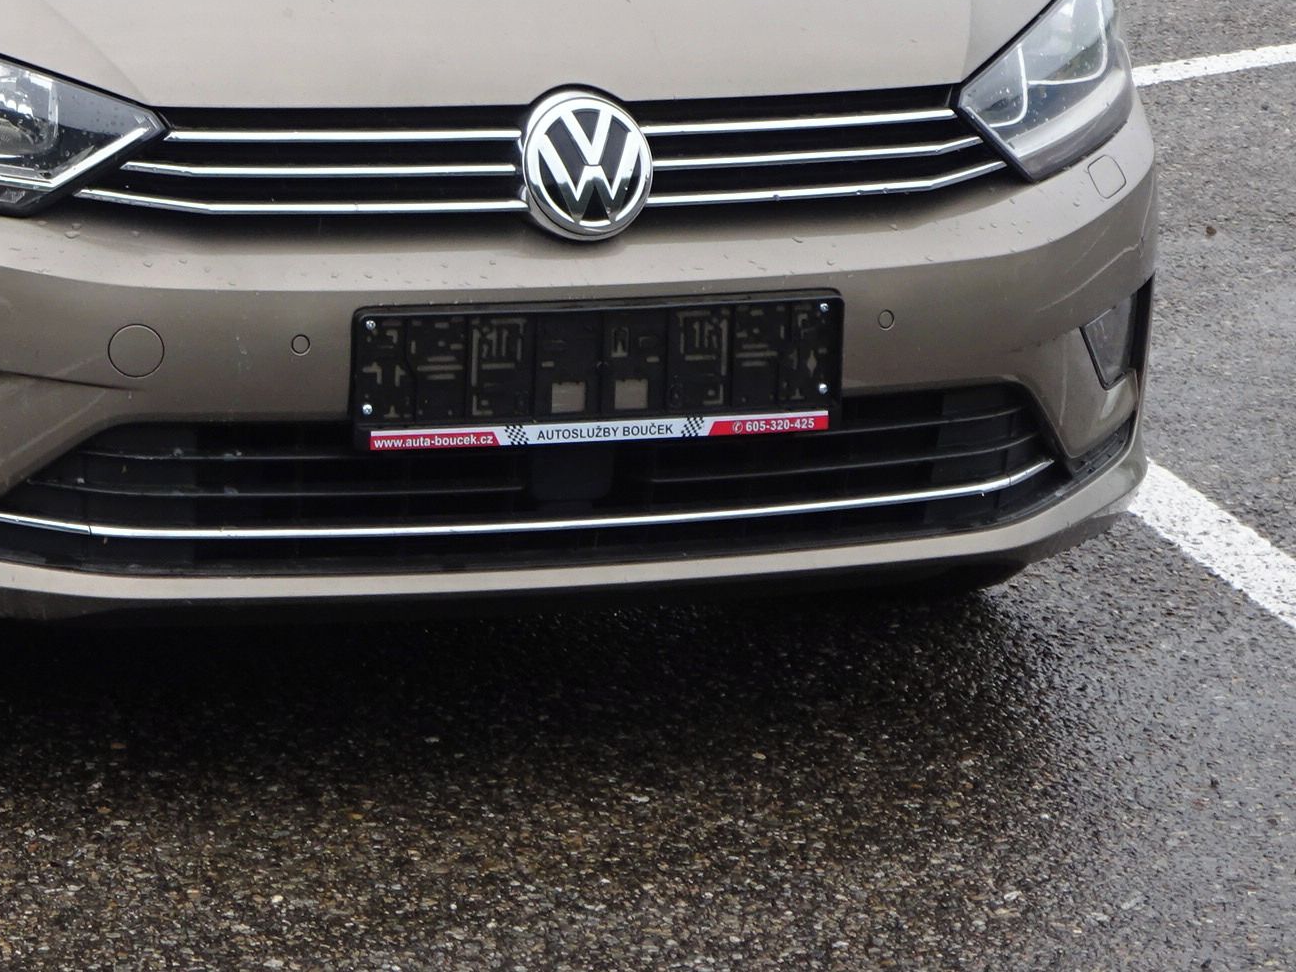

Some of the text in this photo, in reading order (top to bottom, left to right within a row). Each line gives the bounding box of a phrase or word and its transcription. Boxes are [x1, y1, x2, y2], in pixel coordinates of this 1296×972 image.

[537, 422, 674, 441] AUTOSLUŽBY BOUČEK
[745, 418, 815, 432] 605-320-425
[374, 433, 494, 448] www.auta-boucek.cz
